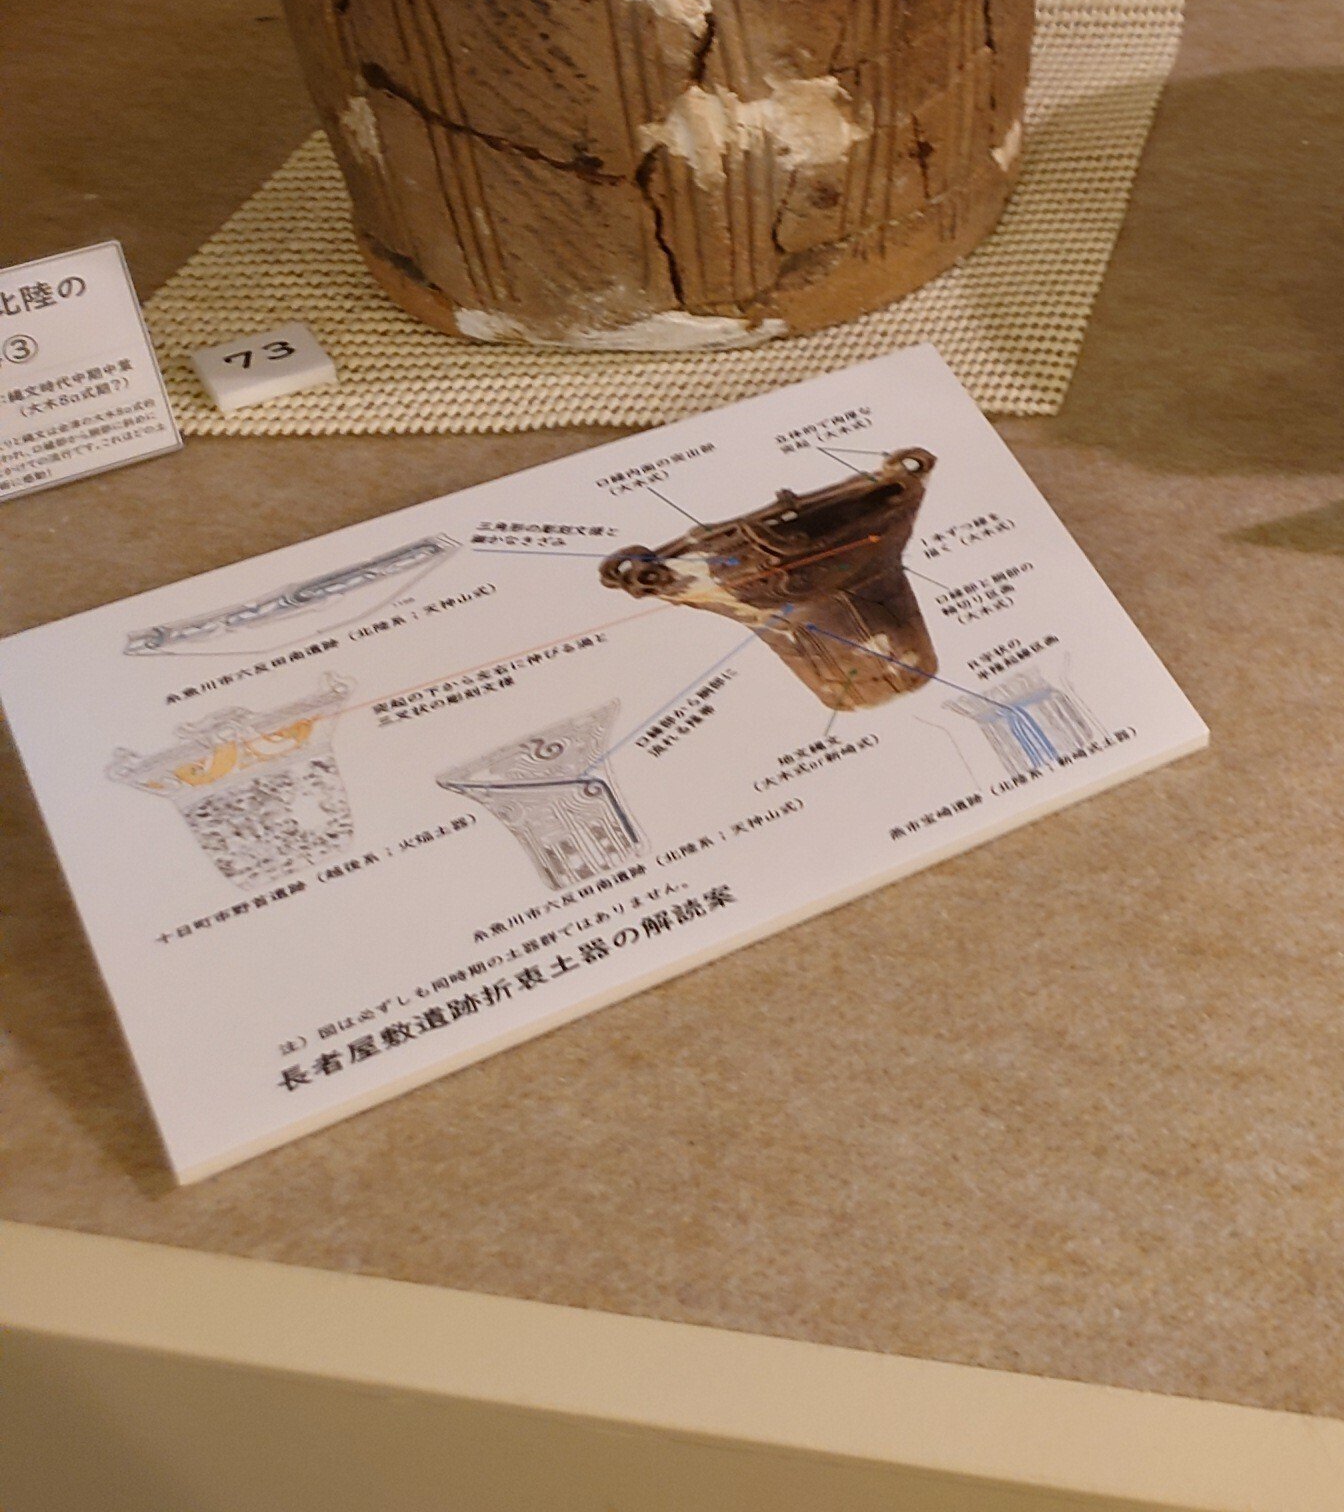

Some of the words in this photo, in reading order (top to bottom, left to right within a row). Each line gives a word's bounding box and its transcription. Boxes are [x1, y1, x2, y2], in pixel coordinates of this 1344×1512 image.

[0, 334, 38, 365] ③
[223, 340, 296, 369] 73
[277, 884, 738, 1092] 長者屋敷遺跡折衷土器の解読案
